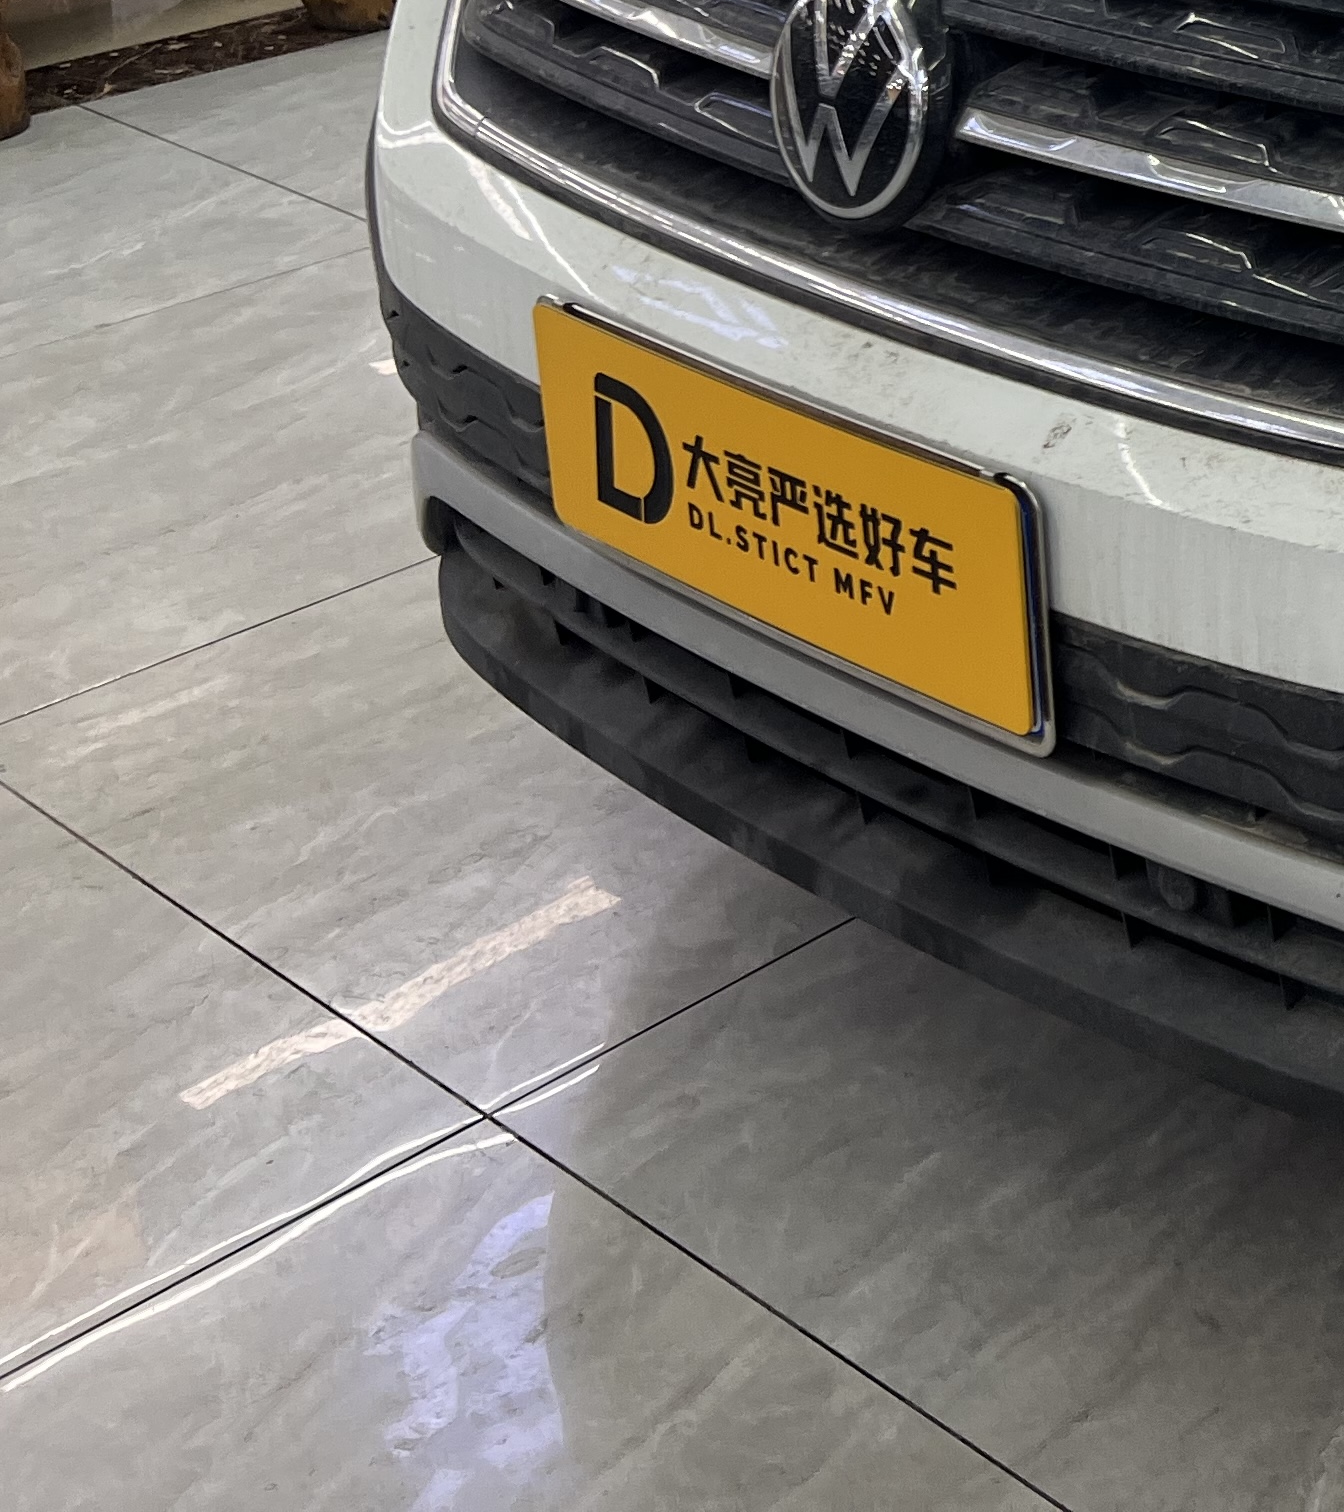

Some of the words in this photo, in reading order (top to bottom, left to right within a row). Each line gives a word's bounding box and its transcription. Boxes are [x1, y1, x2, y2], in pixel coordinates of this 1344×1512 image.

[594, 371, 675, 525] D
[682, 434, 958, 596] 大亮严选好车
[687, 501, 820, 584] DL.STICT
[833, 567, 897, 616] MFV
